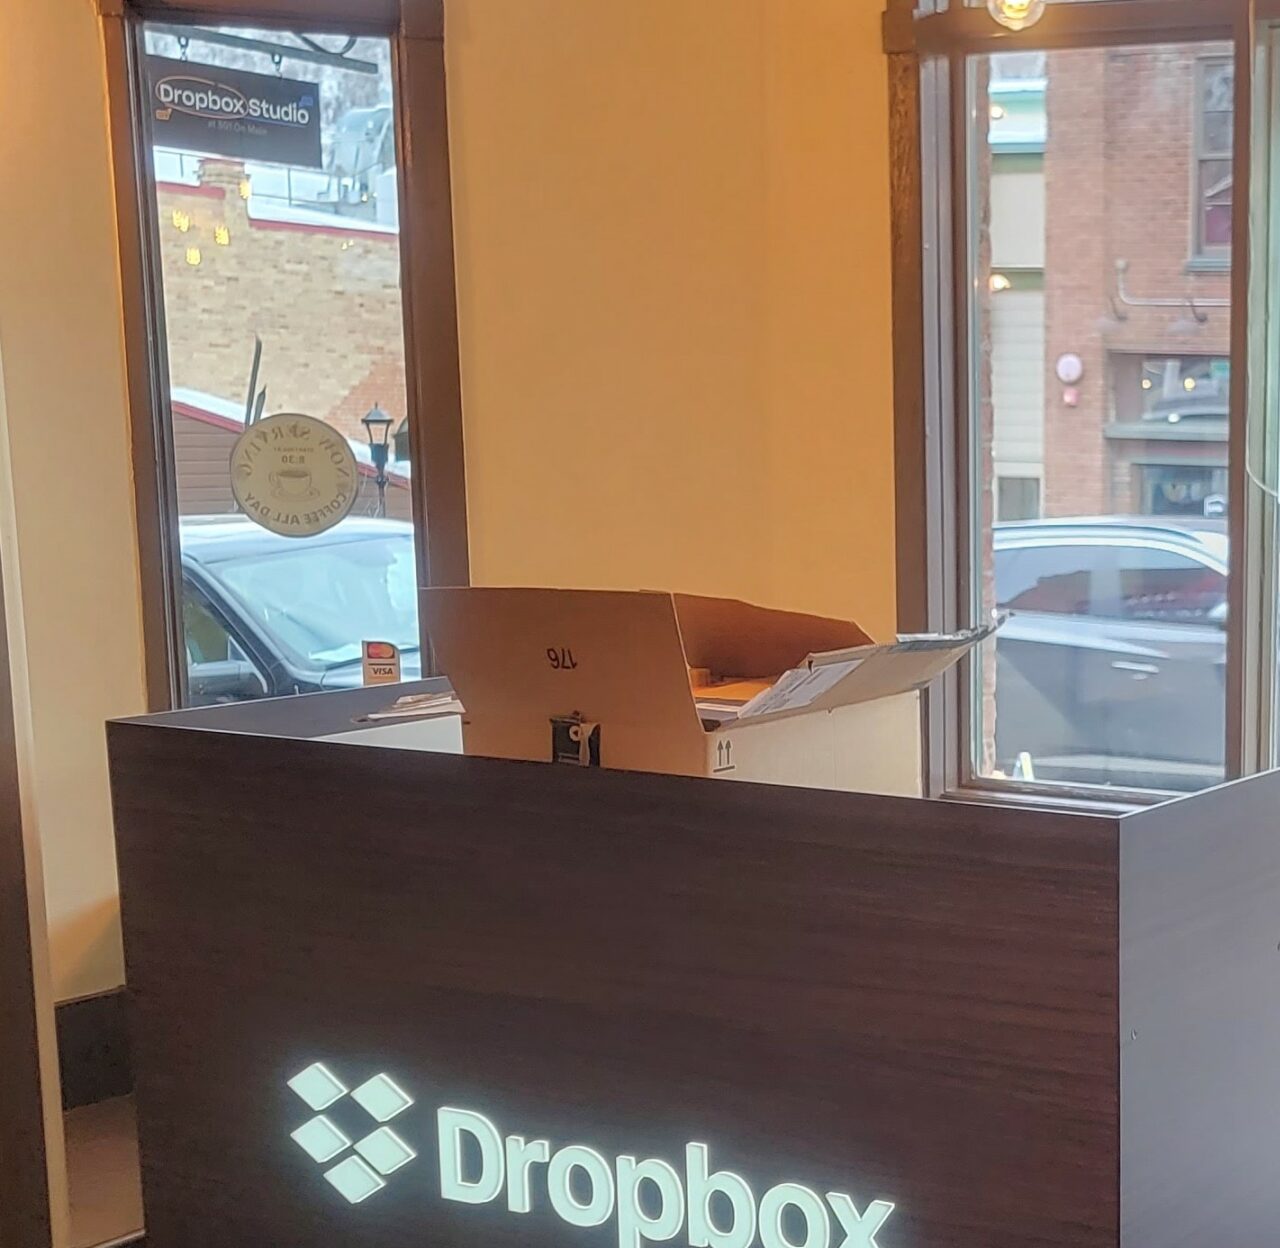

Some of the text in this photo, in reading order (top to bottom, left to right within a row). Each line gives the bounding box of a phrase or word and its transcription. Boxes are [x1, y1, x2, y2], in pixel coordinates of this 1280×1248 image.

[159, 83, 309, 124] Dropbox Studio
[546, 647, 578, 670] 176
[372, 667, 393, 675] VISA
